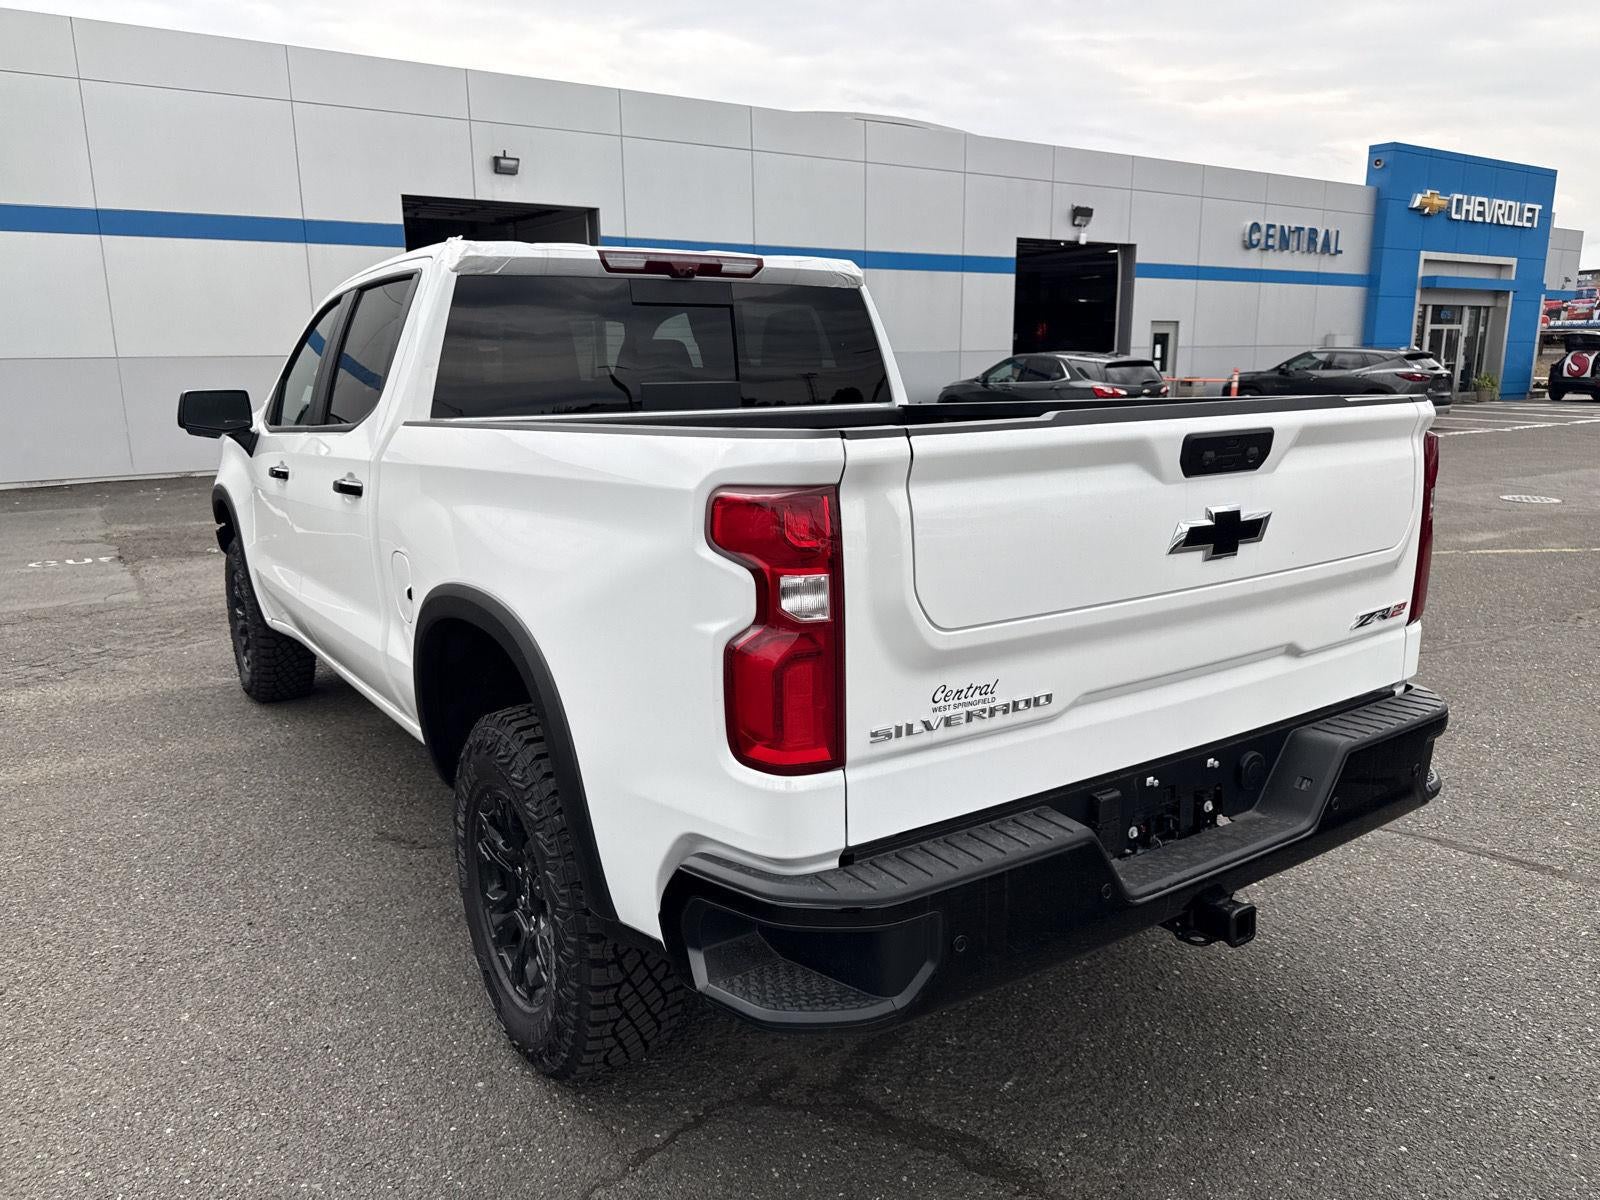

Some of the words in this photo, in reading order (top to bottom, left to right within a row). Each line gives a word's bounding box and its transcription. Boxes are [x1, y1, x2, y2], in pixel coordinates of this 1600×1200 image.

[1450, 193, 1543, 229] CHEVROLET
[1244, 221, 1343, 256] CENTRAL
[1349, 601, 1408, 631] ZR2
[931, 678, 999, 704] Central
[931, 704, 952, 713] WEST
[952, 696, 997, 710] SPRINGFIELD
[869, 691, 1053, 744] SILVERADO
